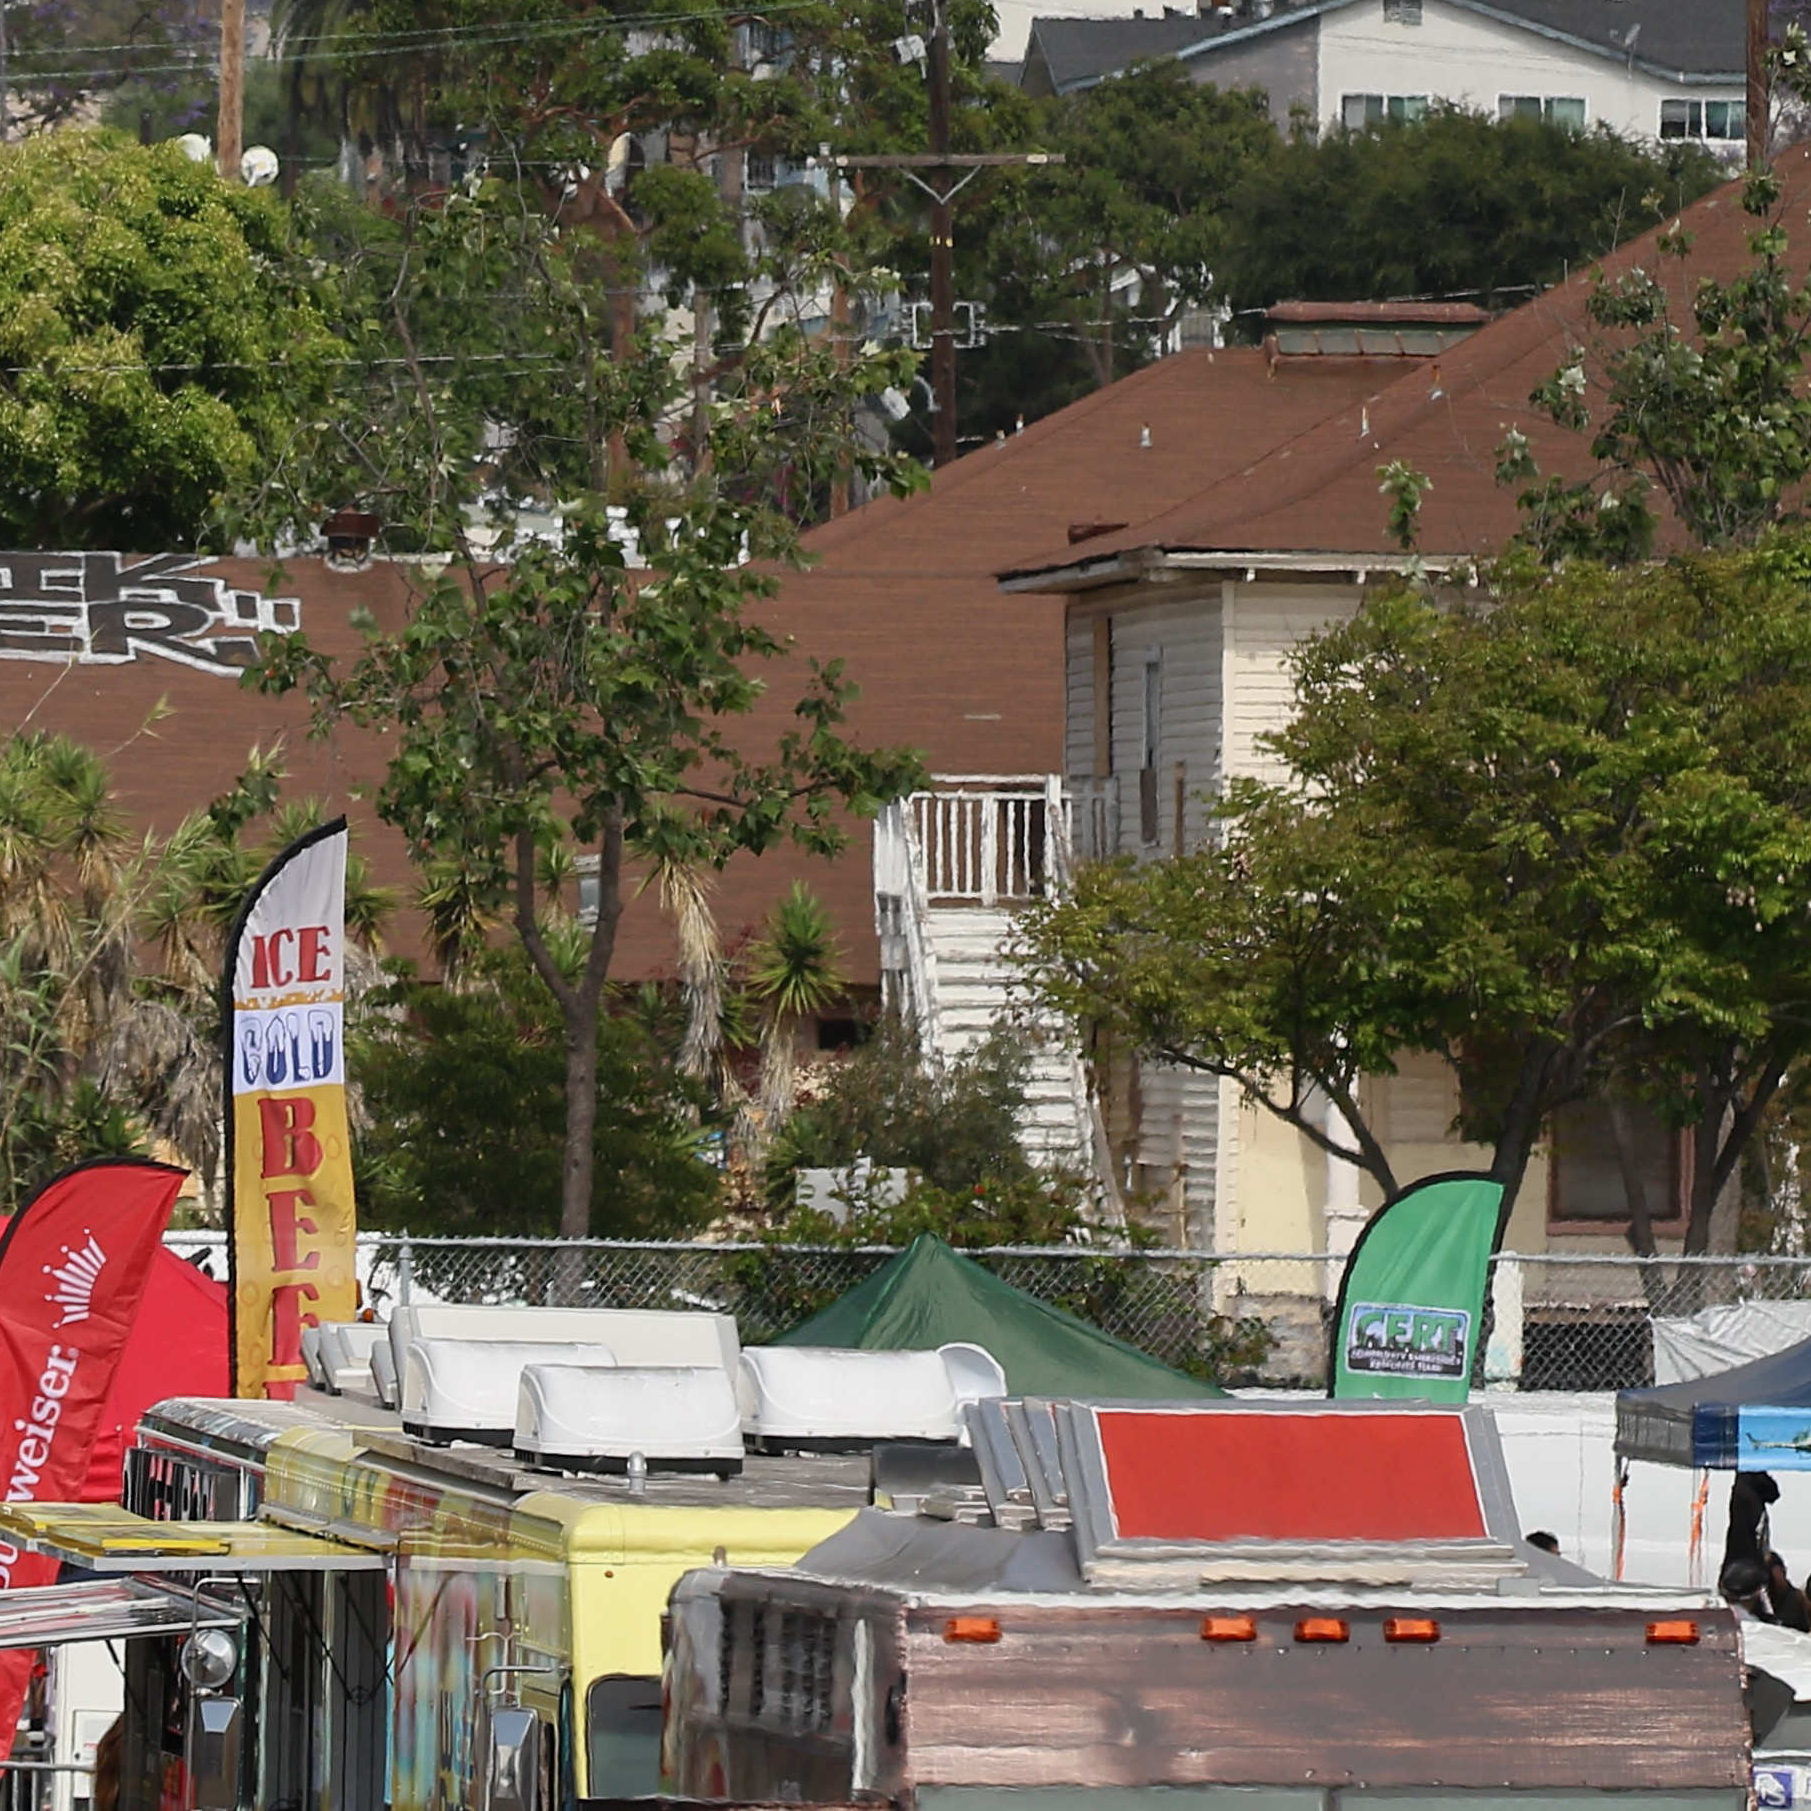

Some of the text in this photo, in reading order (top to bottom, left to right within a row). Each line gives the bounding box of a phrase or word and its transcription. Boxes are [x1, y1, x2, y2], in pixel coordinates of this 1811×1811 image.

[250, 925, 331, 989] ICE
[240, 1008, 335, 1086] COLD
[257, 1095, 323, 1401] BEE
[1356, 1311, 1460, 1355] CERT
